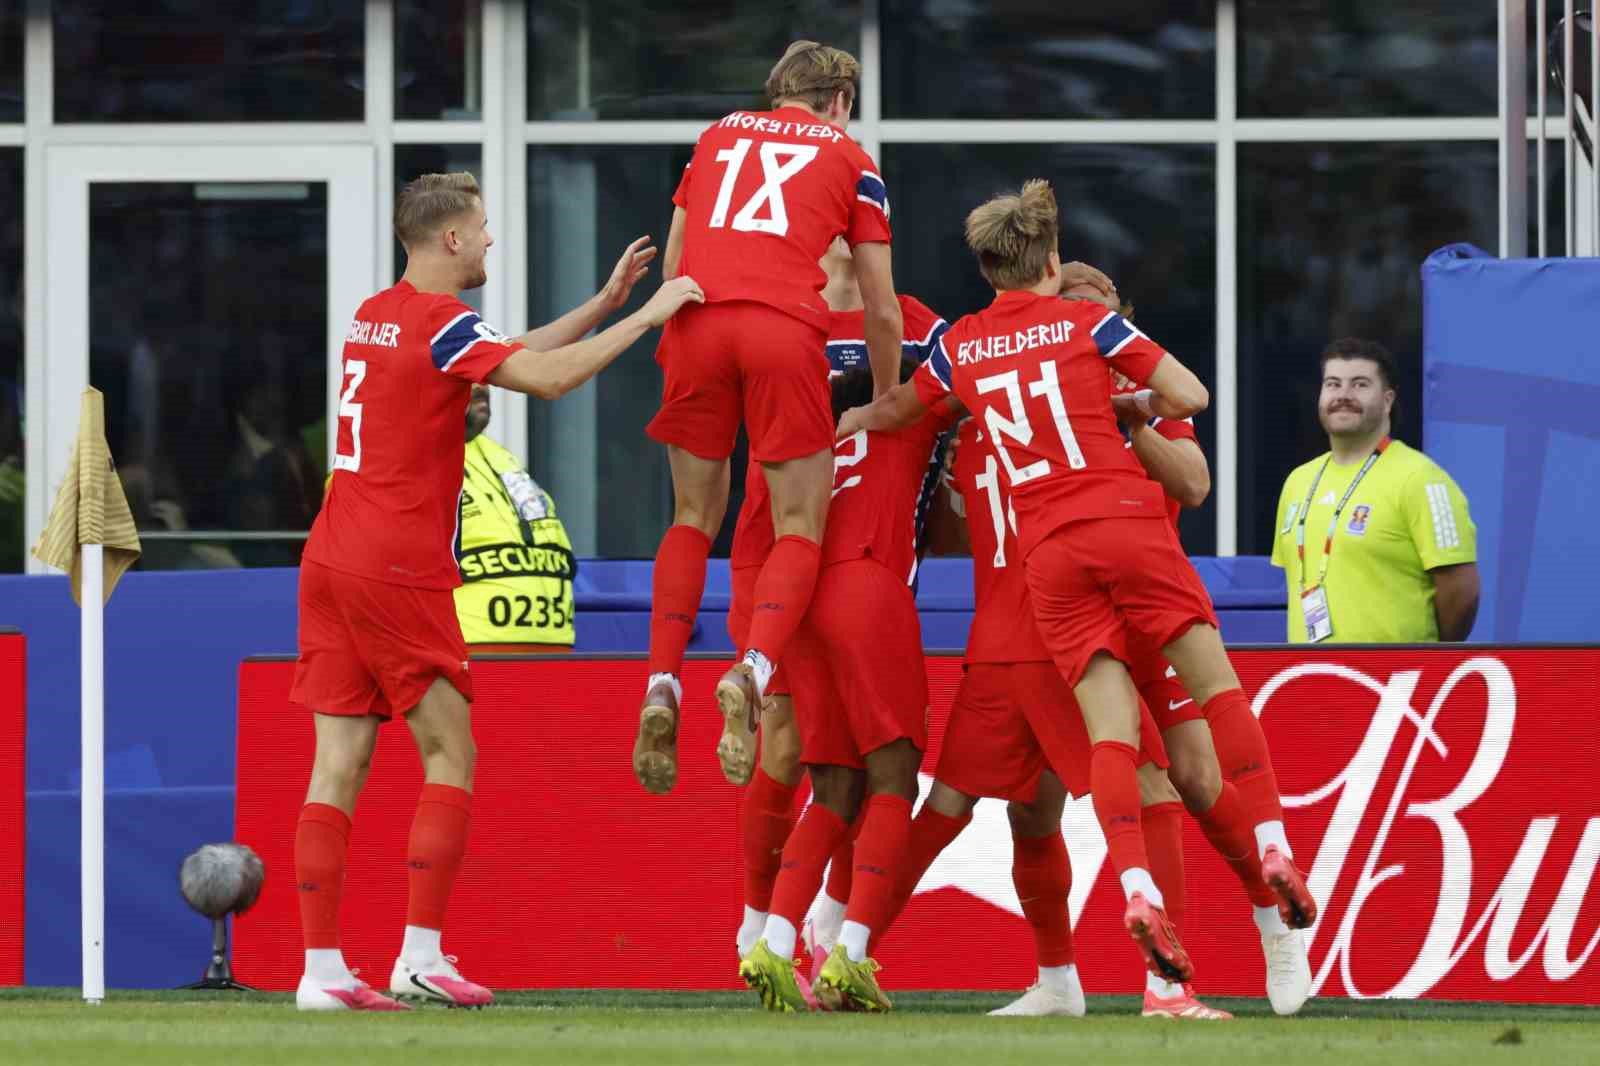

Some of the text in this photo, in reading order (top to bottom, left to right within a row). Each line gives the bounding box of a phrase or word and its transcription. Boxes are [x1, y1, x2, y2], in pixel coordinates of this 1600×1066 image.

[708, 137, 820, 238] 18
[957, 319, 1076, 366] SCHJELDERUP
[975, 359, 1088, 487] 21
